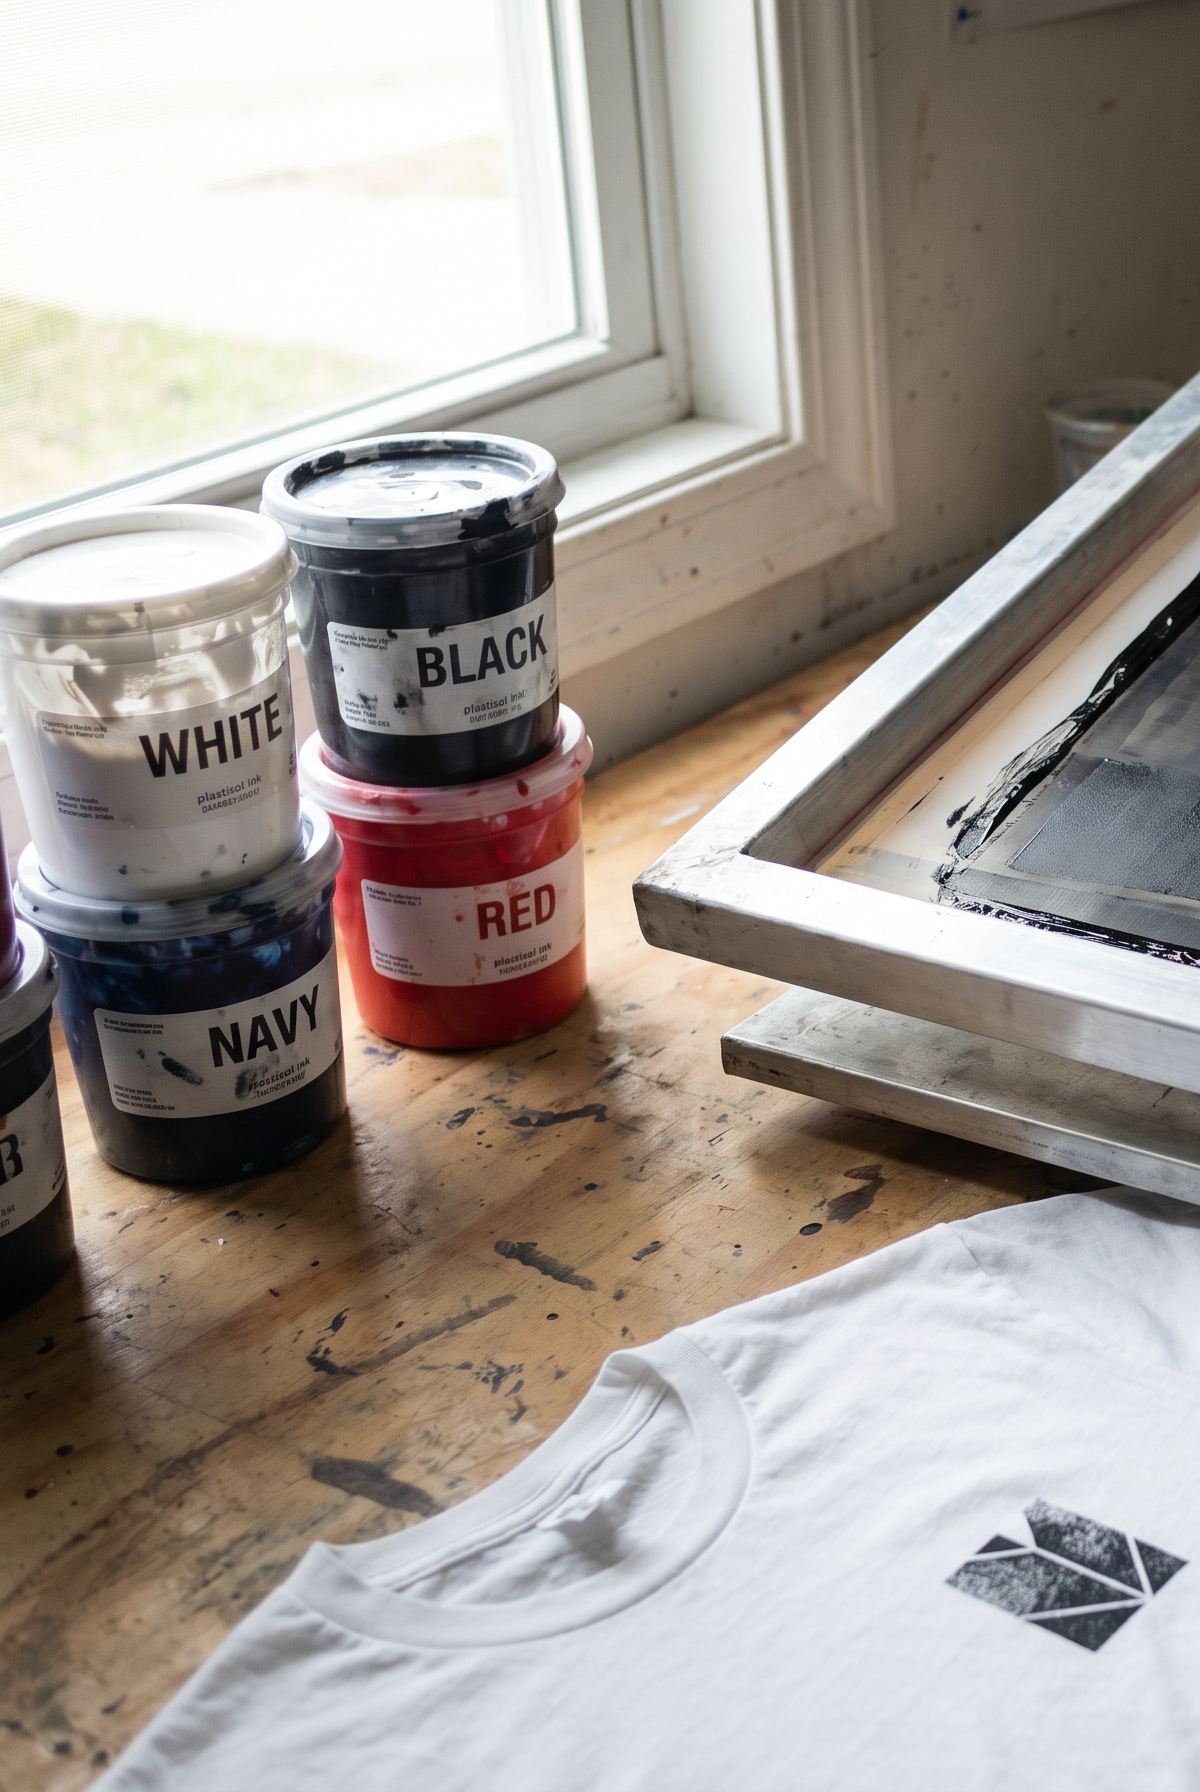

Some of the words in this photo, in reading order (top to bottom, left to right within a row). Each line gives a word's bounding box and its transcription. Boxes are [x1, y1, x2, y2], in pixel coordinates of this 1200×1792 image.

[415, 613, 548, 689] BLACK
[138, 692, 283, 779] WHITE
[197, 780, 245, 806] plastisol
[477, 883, 556, 940] RED
[208, 983, 319, 1068] NAVY
